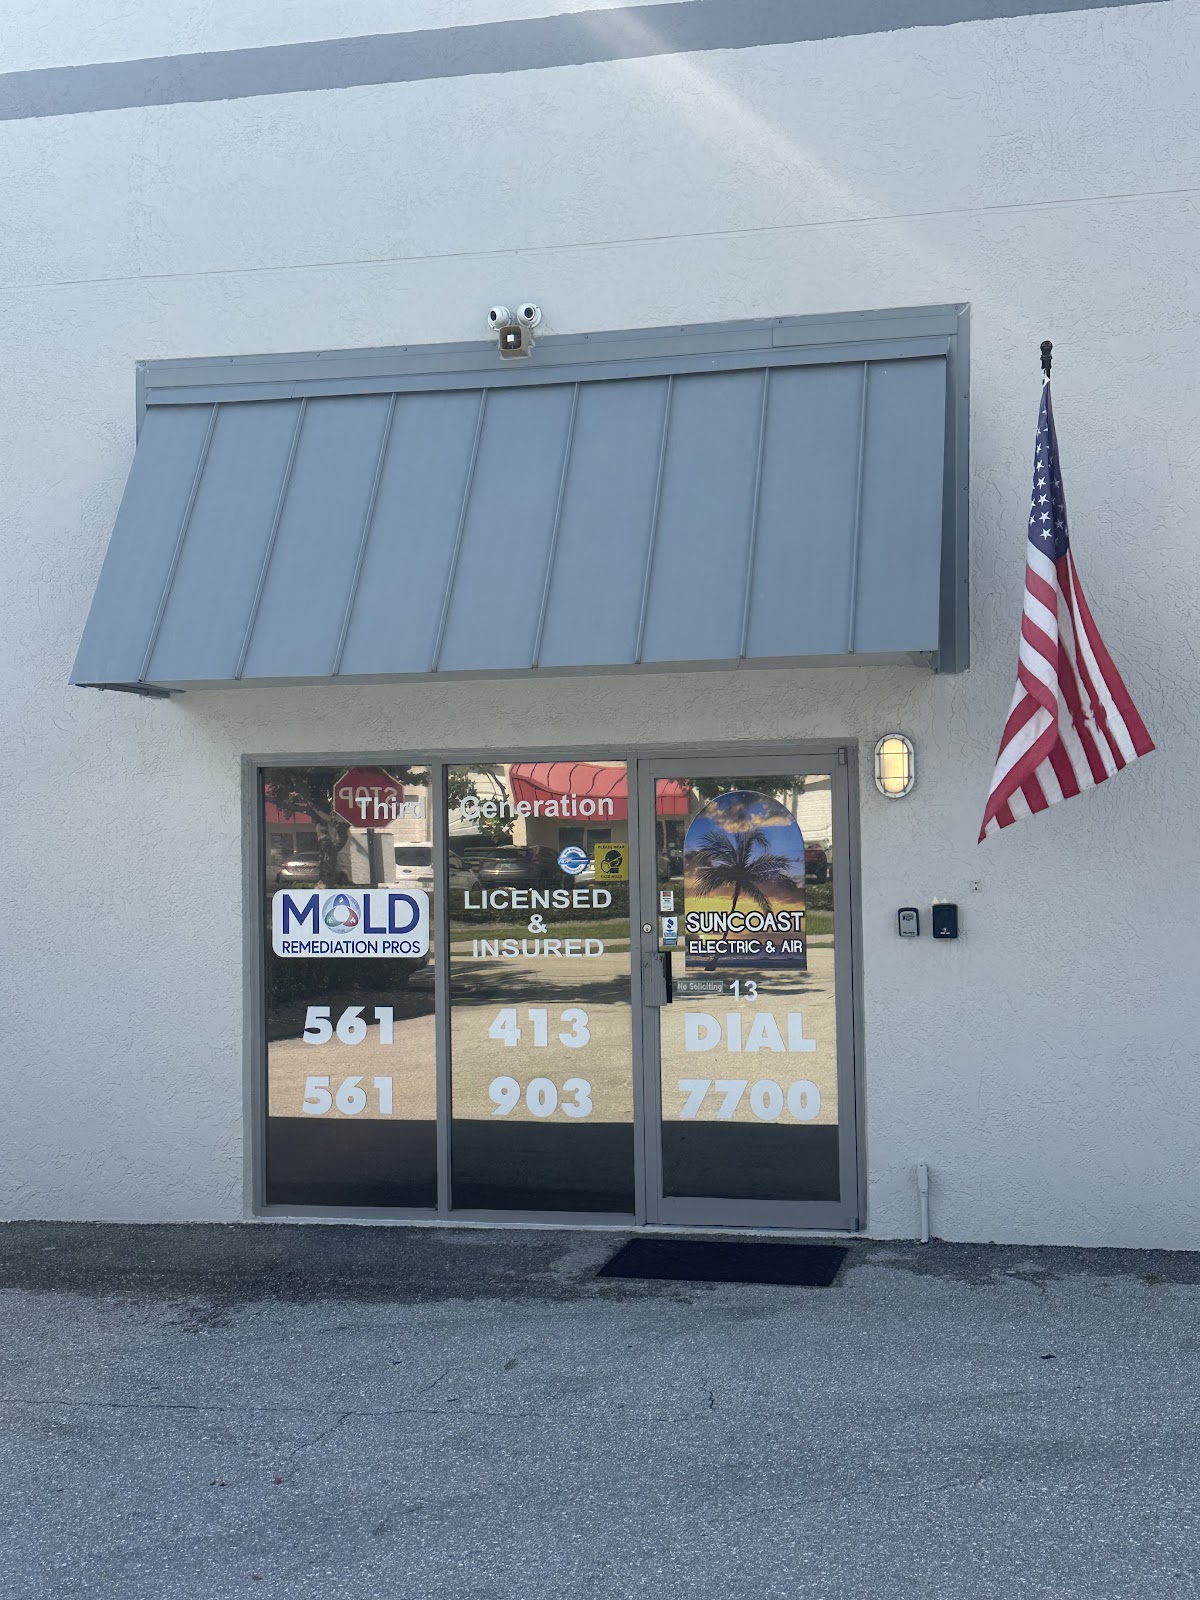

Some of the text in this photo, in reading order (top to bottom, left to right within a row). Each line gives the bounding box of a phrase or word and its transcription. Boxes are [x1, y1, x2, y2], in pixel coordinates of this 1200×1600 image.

[355, 794, 615, 820] Third Generation
[464, 889, 612, 910] LICENSED
[282, 893, 420, 935] MOLD
[527, 914, 547, 933] &
[685, 911, 804, 932] SUNCOAST
[282, 940, 420, 954] REMEDIATION PROS
[472, 938, 605, 958] INSURED
[688, 940, 761, 954] ELECTRIC
[765, 940, 776, 954] &
[781, 940, 804, 954] AIR
[677, 982, 723, 992] No Soliciting
[729, 980, 759, 1002] 13
[302, 1005, 817, 1053] 561 413 DIAL
[302, 1075, 822, 1122] 561 903 7700
